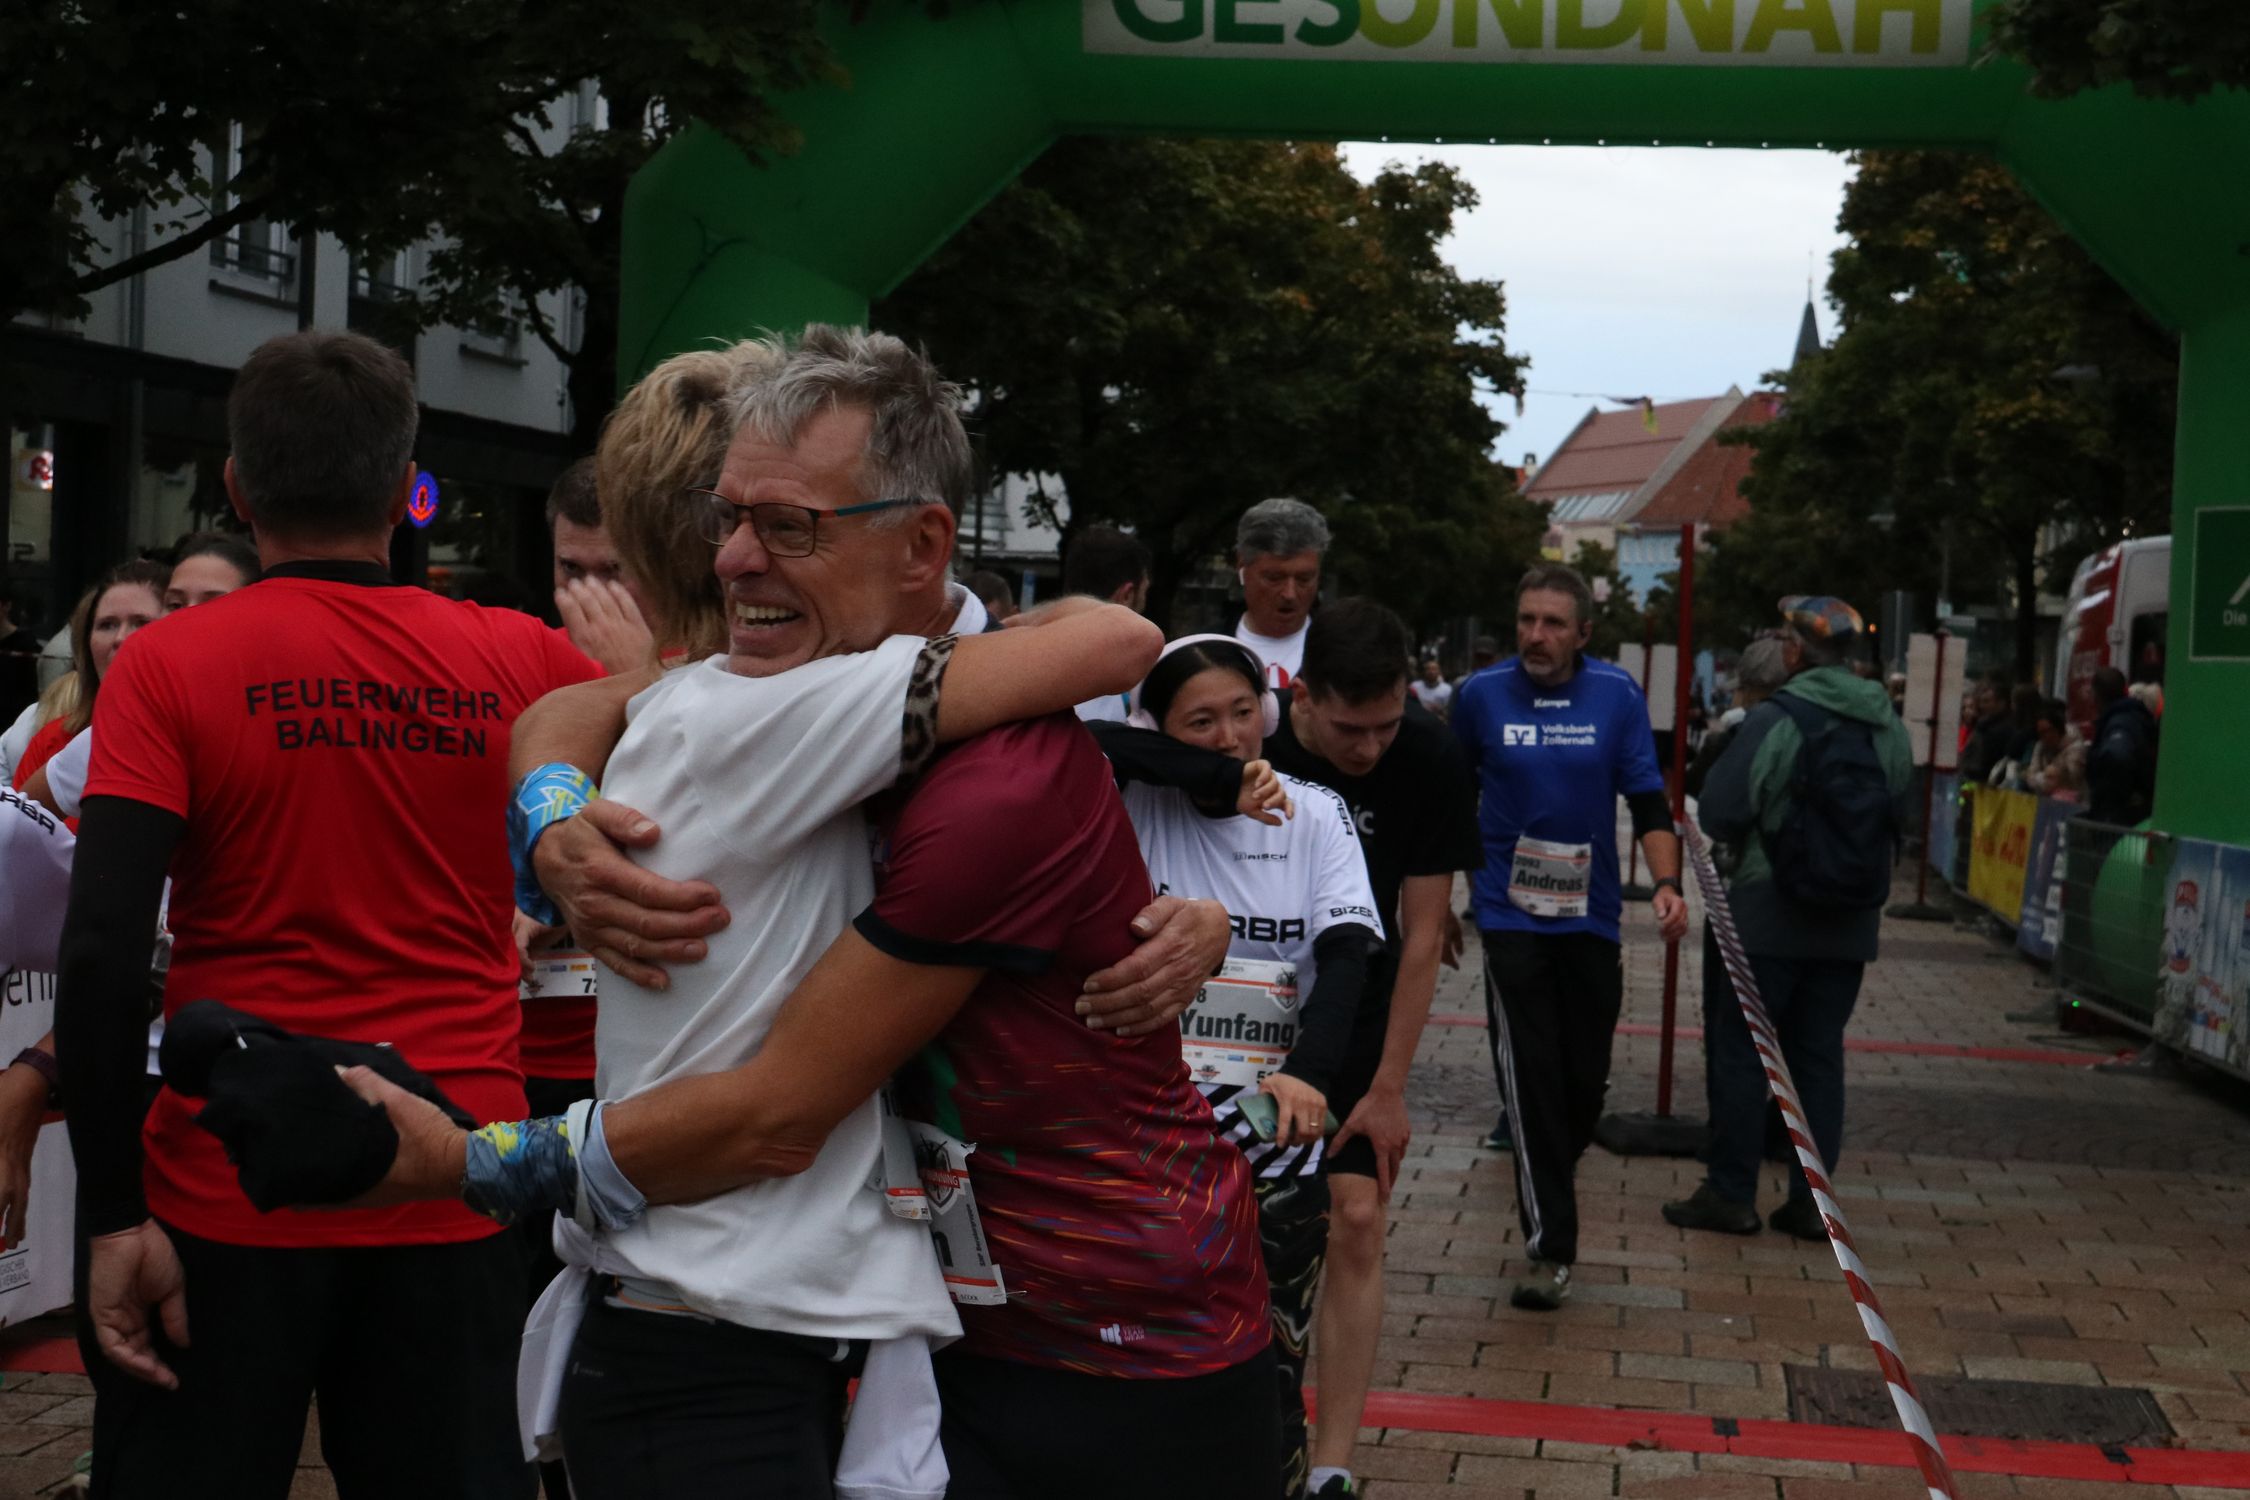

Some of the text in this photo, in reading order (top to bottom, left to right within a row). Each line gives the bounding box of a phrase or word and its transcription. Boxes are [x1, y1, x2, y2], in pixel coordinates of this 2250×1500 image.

[245, 678, 502, 721] FEUERWEHR
[277, 717, 486, 757] BALINGEN
[1541, 723, 1597, 735] Volksbank
[1542, 735, 1596, 746] Zollernalb
[1515, 869, 1583, 892] Andreas
[1180, 1009, 1295, 1049] Yunfang
